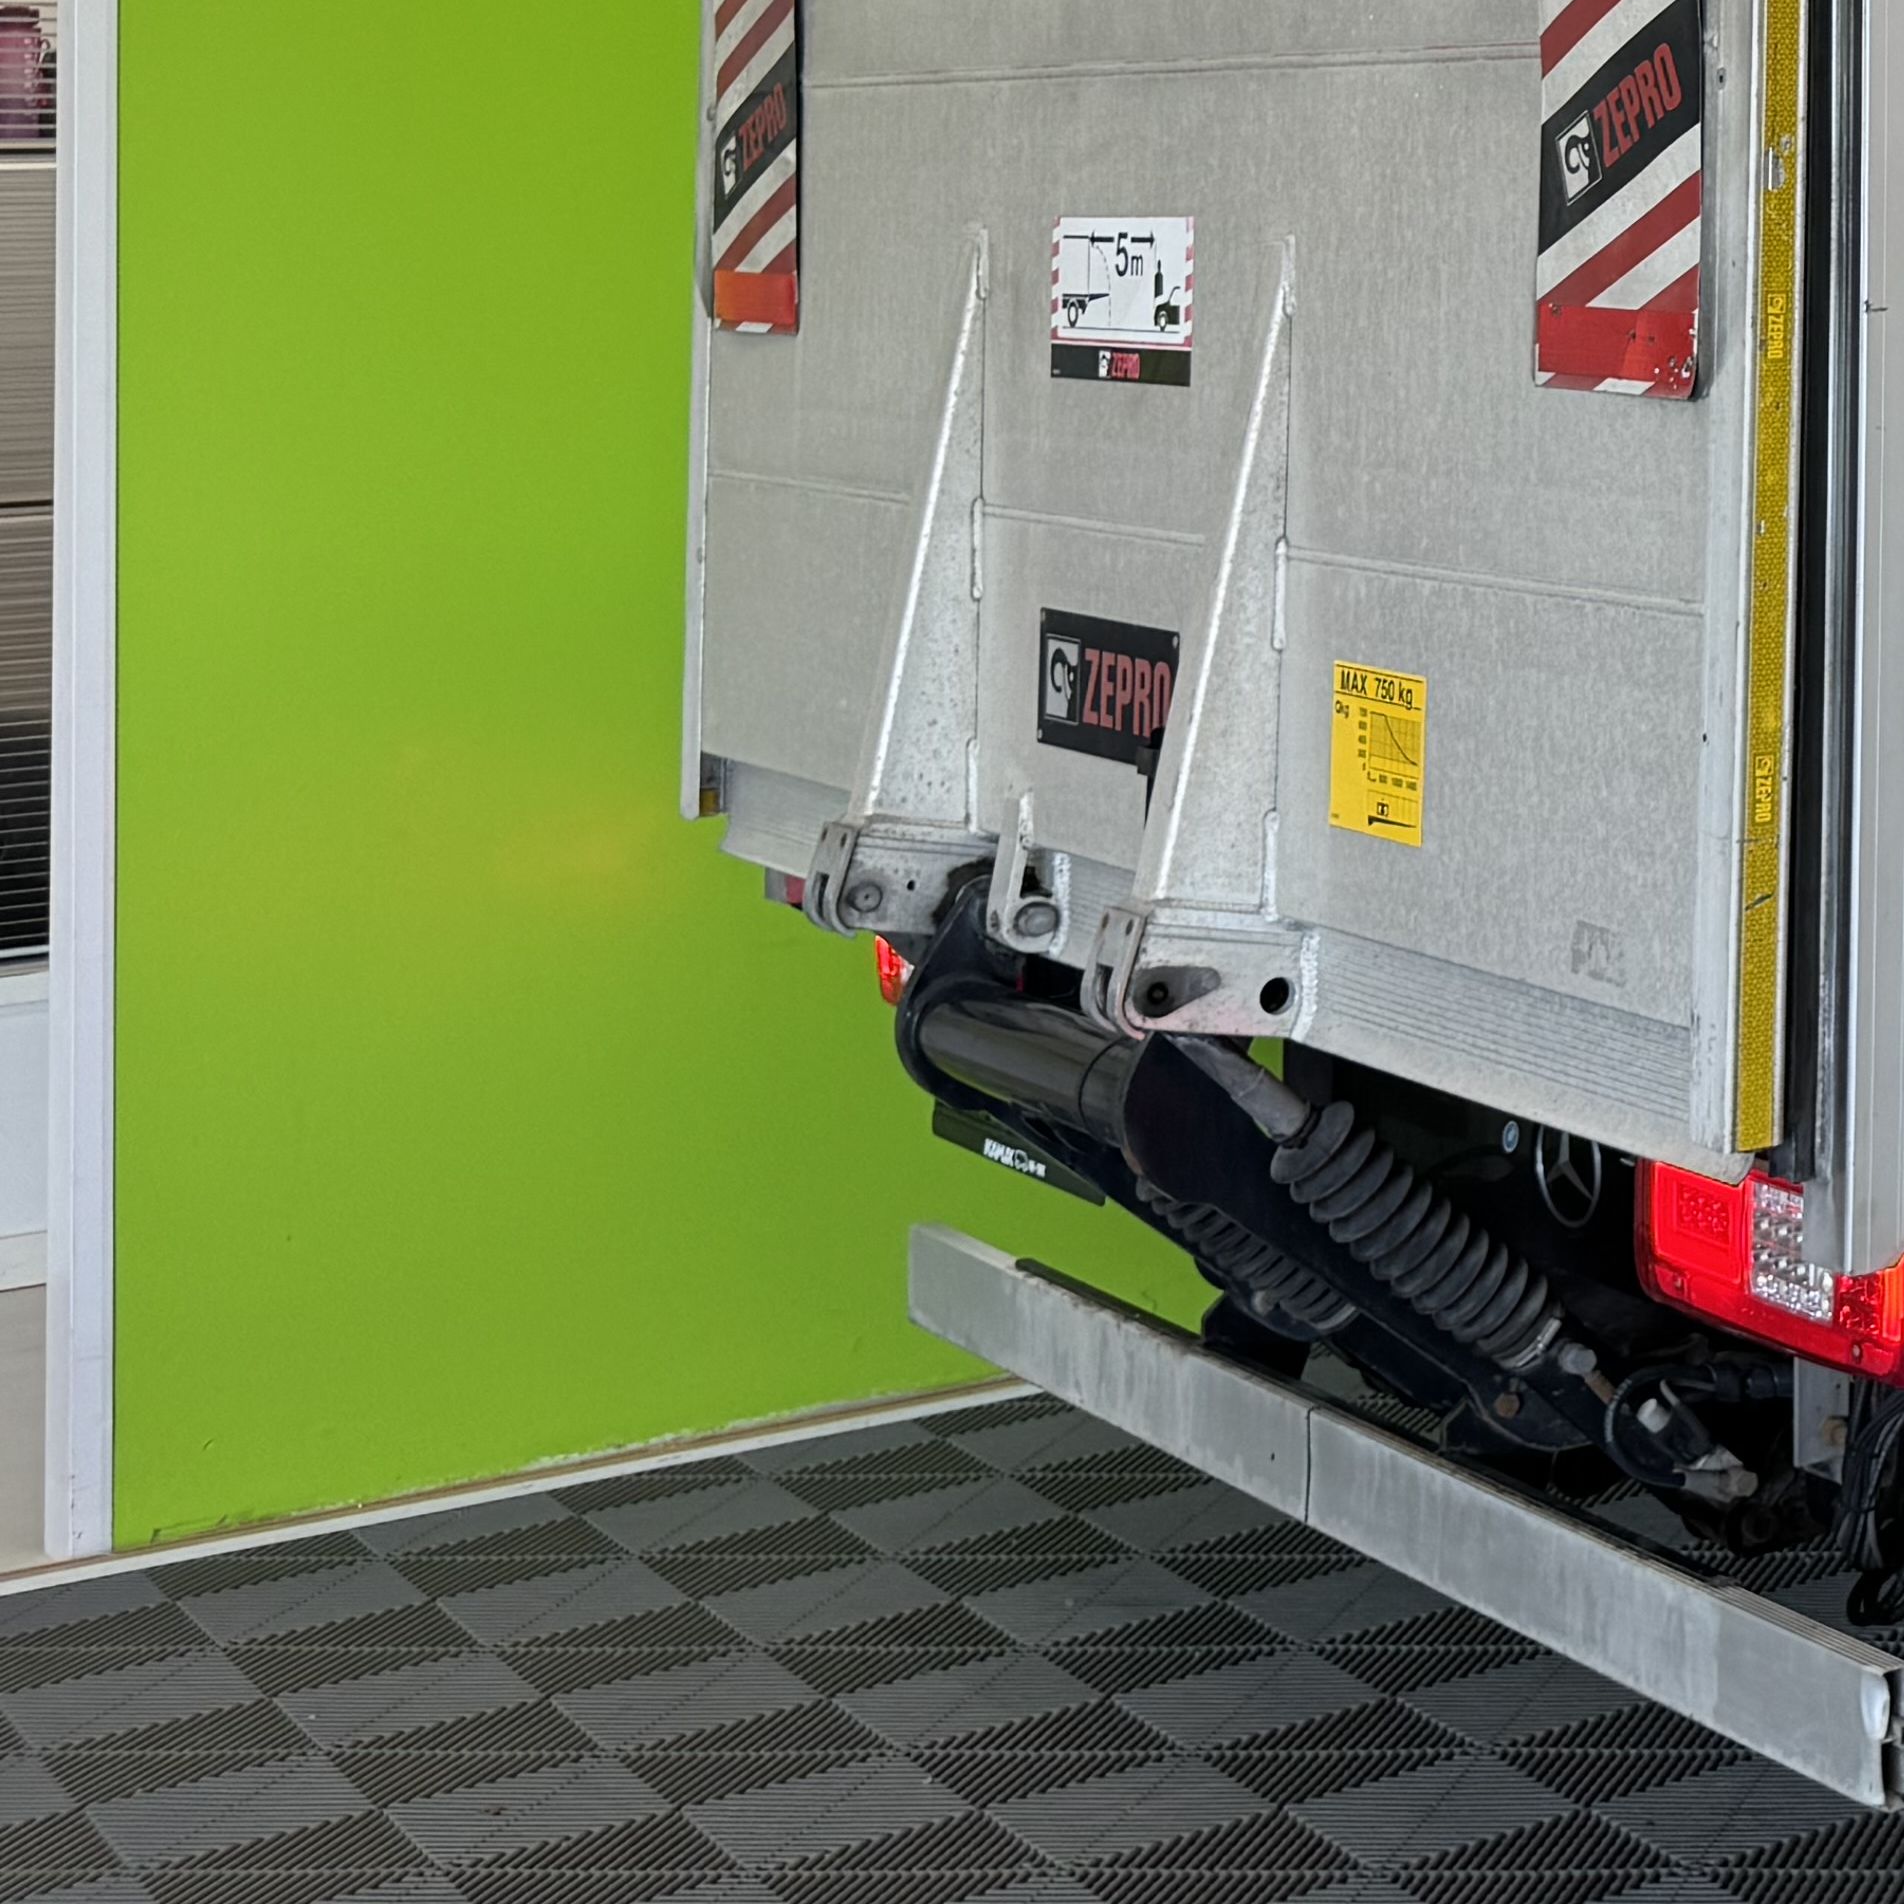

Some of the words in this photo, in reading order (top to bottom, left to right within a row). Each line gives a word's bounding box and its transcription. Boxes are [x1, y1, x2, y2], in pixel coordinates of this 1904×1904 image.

[738, 82, 787, 172] ZEPRO
[1593, 42, 1682, 168] ZEPRO
[1768, 315, 1784, 358] ZEPRO
[1111, 352, 1140, 379] ZEPRO
[1082, 648, 1171, 738] ZEPRO
[1340, 669, 1367, 696] MAX
[1374, 677, 1395, 702] 750
[1398, 681, 1413, 710] kg
[1755, 777, 1772, 823] ZEPRO
